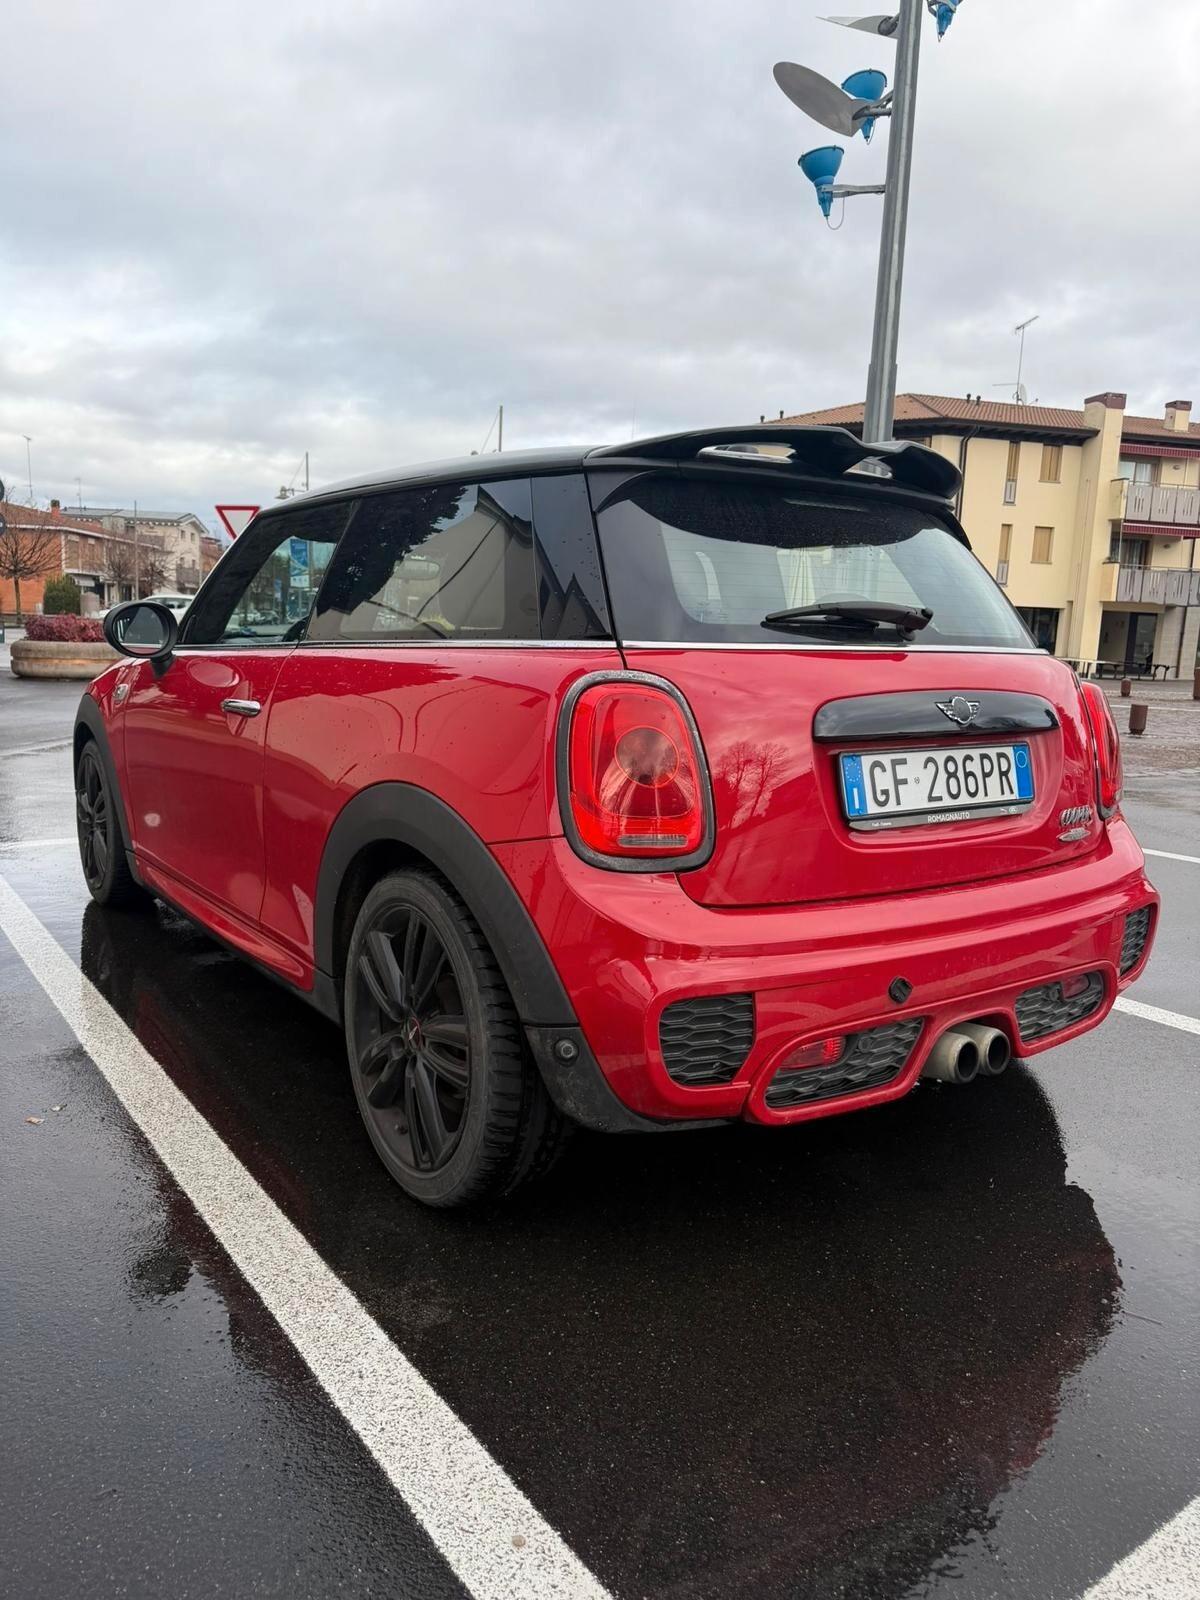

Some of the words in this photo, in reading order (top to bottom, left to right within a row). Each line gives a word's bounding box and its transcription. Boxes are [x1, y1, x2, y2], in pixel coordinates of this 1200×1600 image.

[869, 757, 909, 807] GF
[923, 752, 1015, 802] 286PR
[928, 812, 970, 824] ROMAGNAUTO
